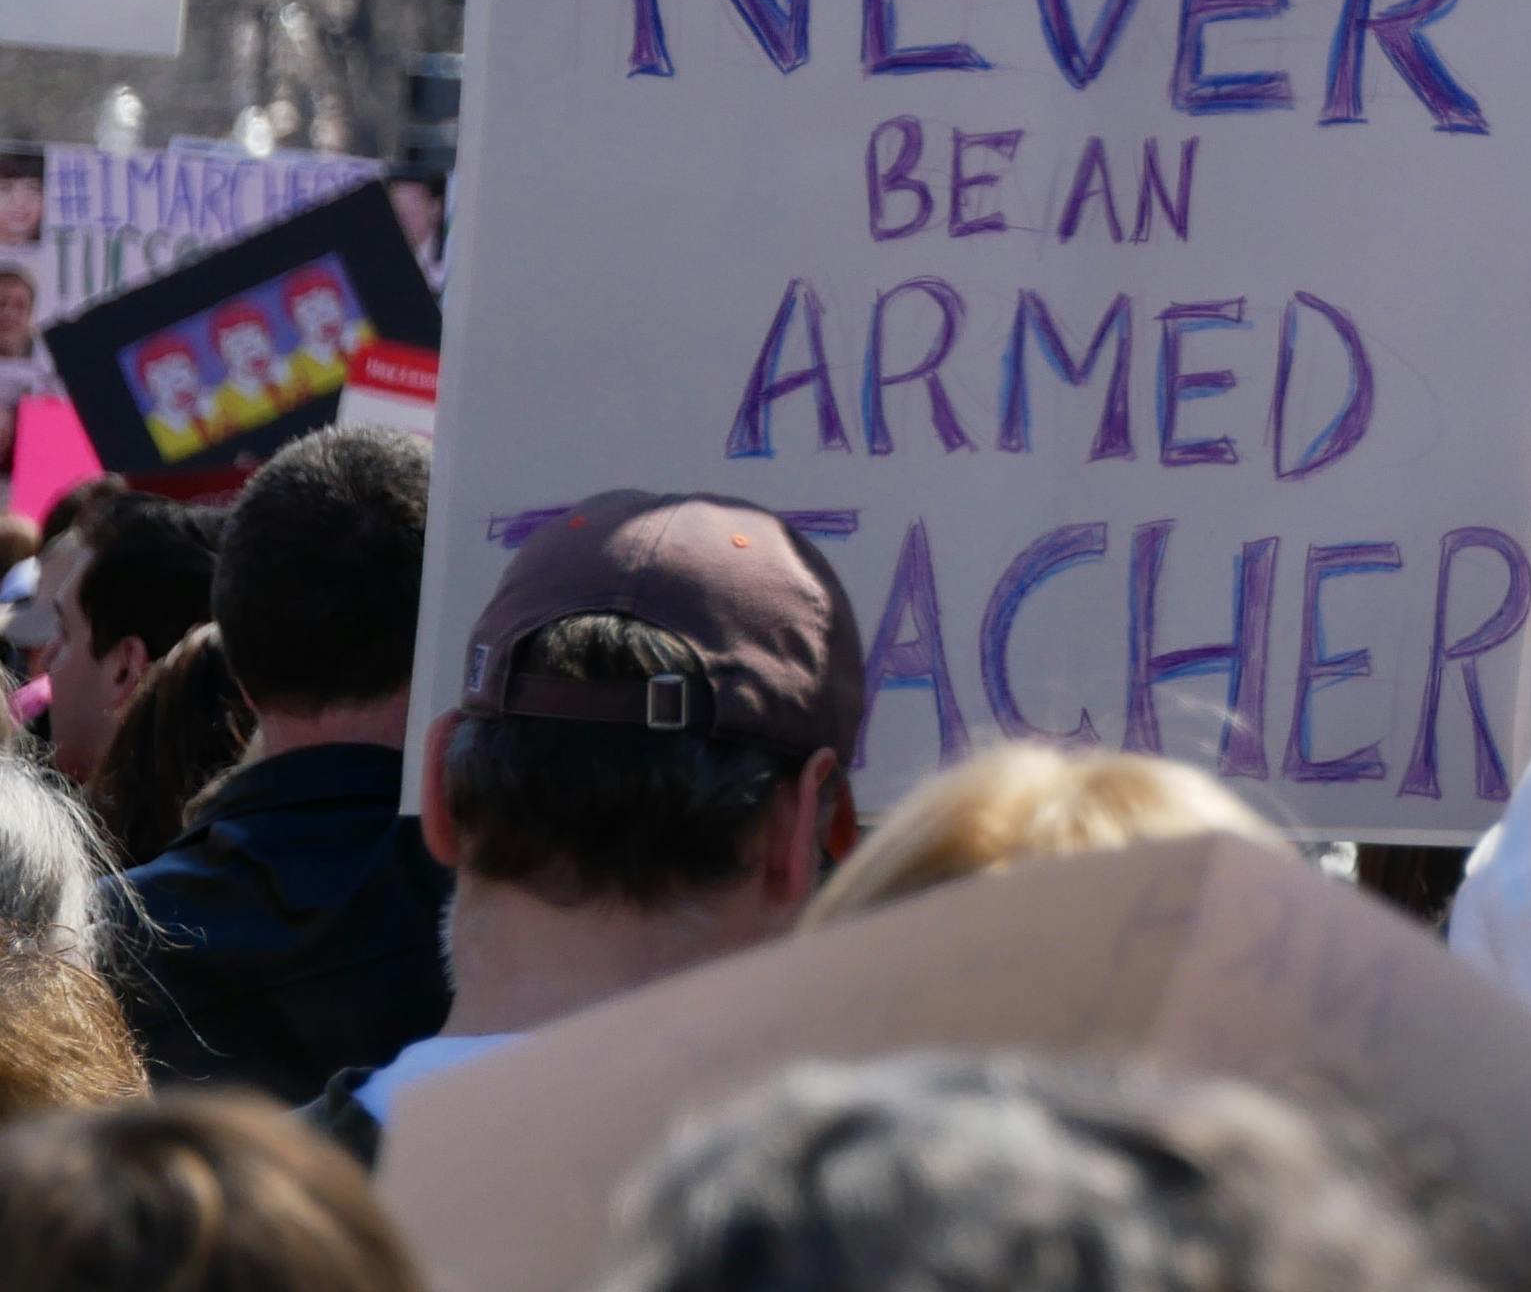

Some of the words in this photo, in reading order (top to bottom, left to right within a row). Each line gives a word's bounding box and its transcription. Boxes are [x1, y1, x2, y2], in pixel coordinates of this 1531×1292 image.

[865, 114, 1025, 241] BE
[1056, 135, 1199, 244] AN
[725, 276, 1376, 481] ARMED
